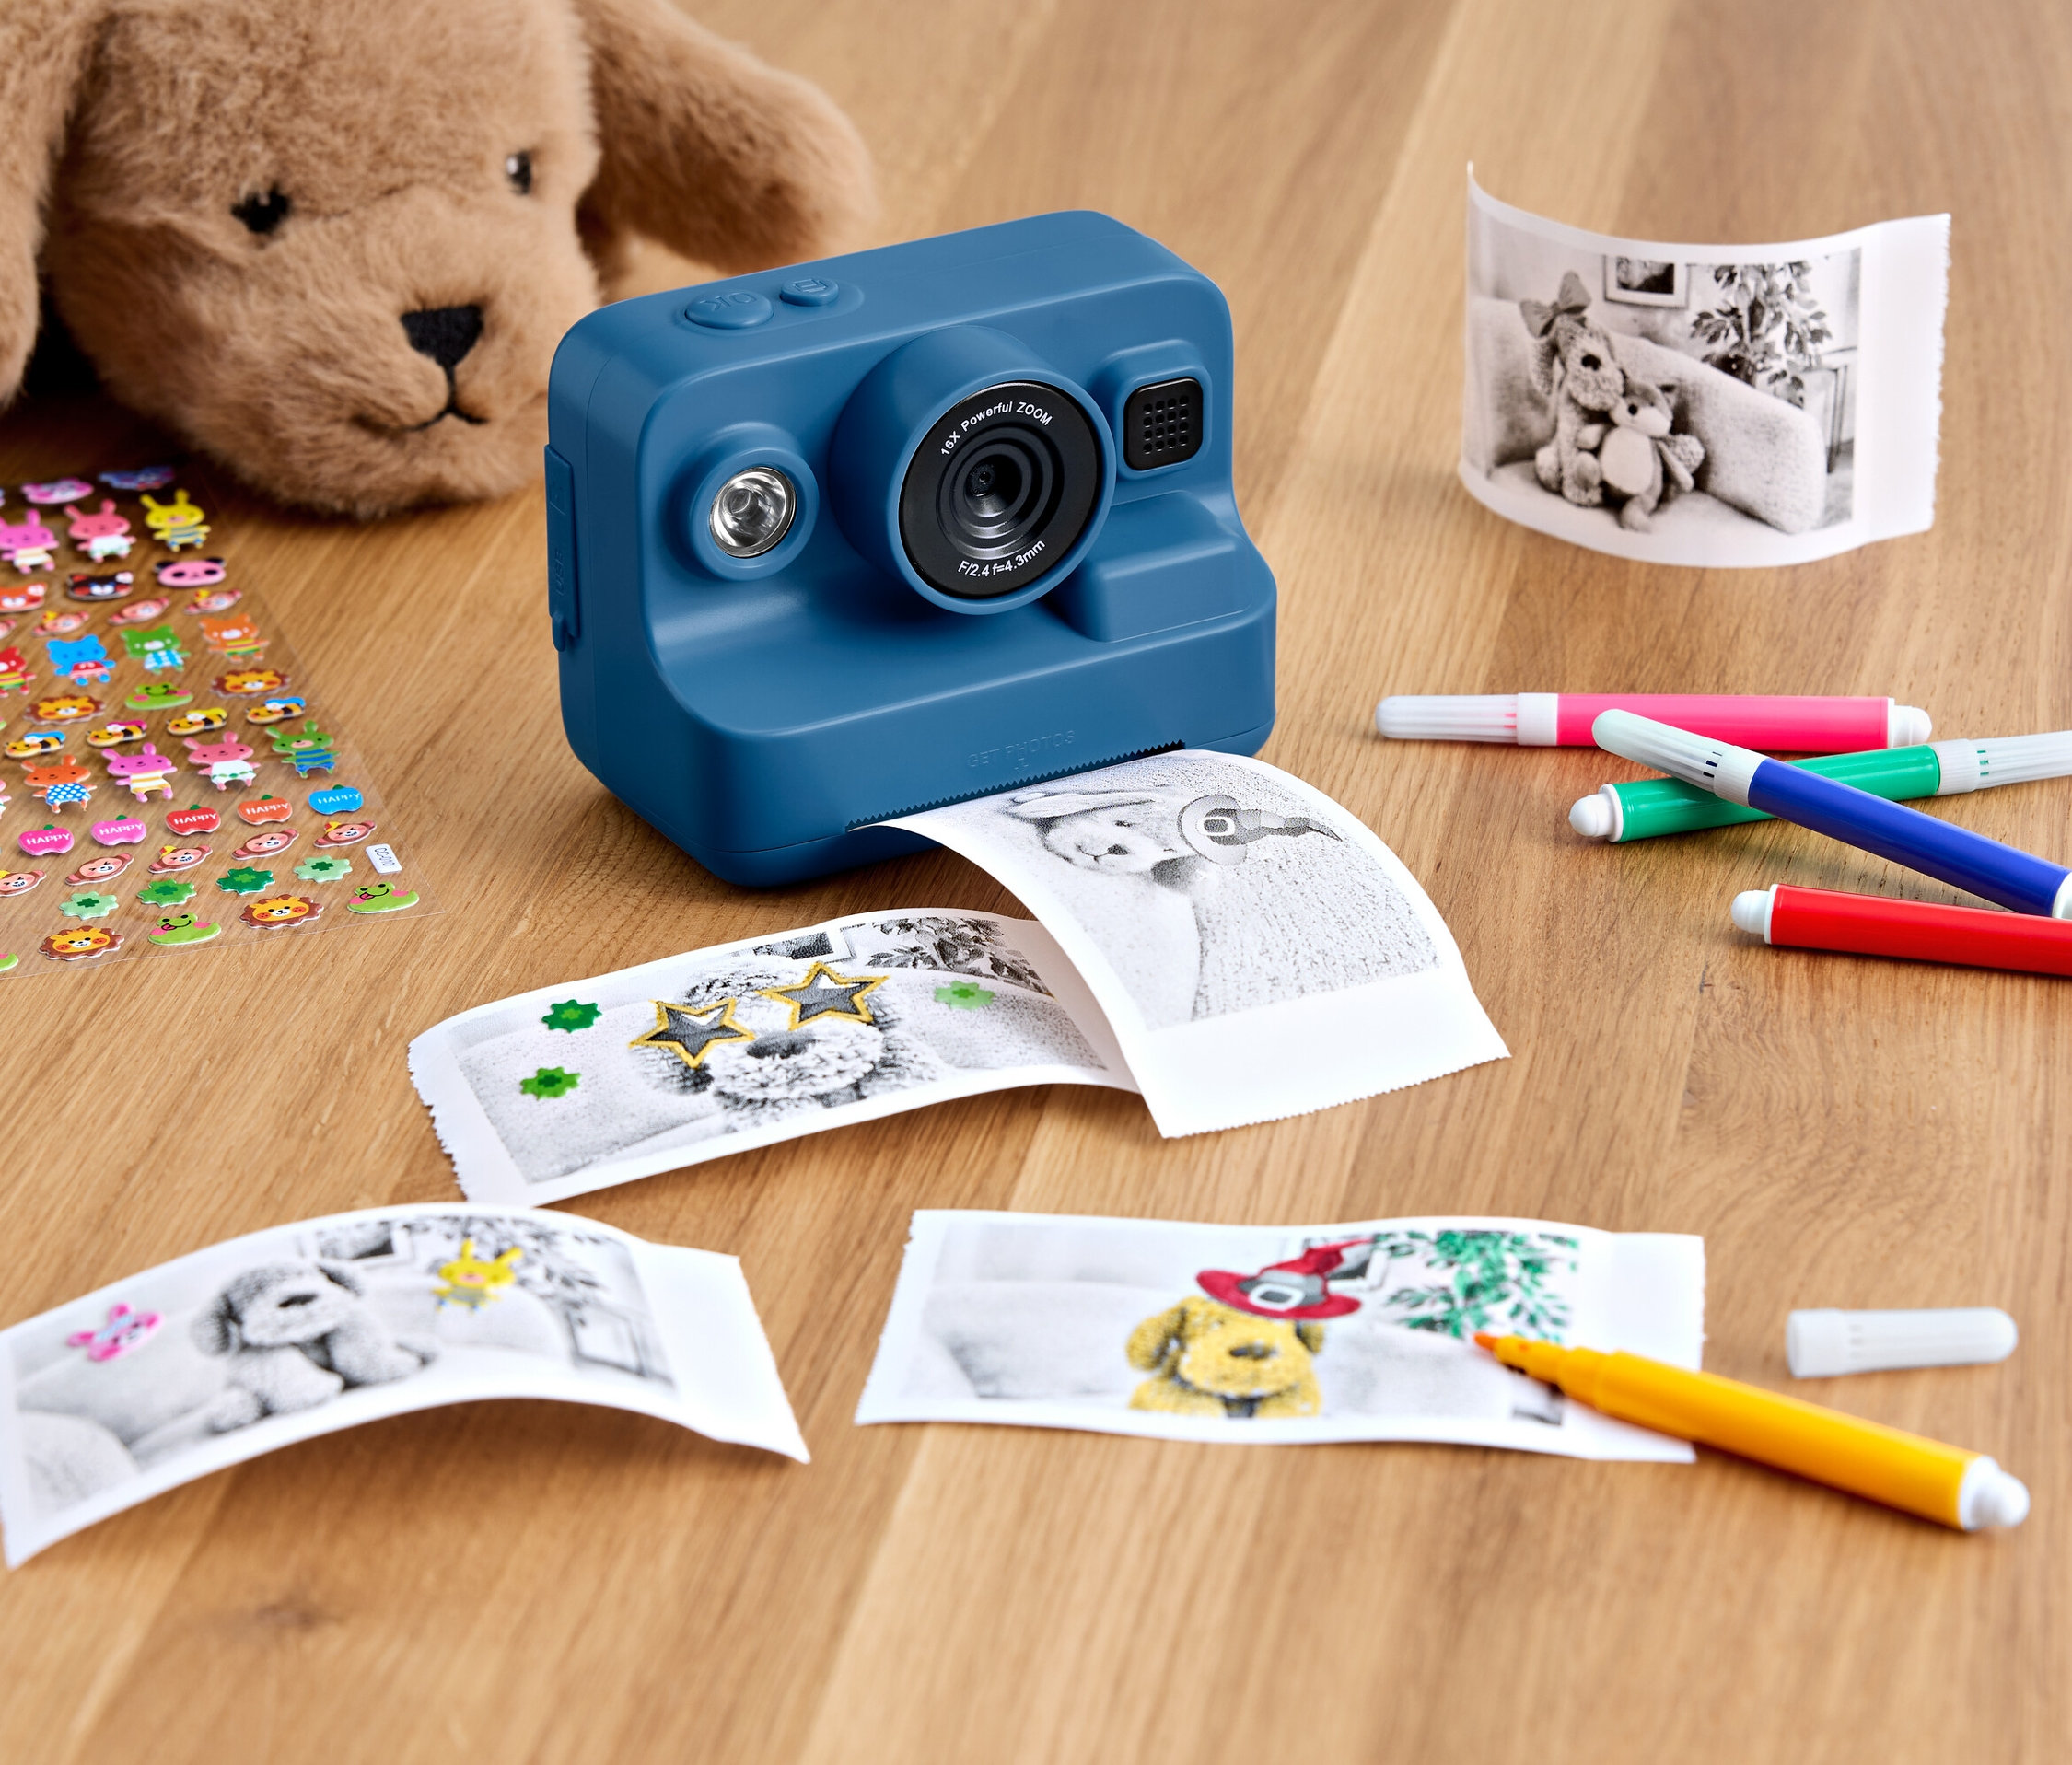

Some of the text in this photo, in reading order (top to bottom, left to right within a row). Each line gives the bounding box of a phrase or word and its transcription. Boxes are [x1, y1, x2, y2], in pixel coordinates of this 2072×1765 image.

[940, 401, 1053, 455] 16X Powerful ZOOM
[958, 540, 1046, 577] F/2.4 f=4.3mm
[966, 729, 1076, 768] GET PHOTOS
[317, 792, 361, 805] HAPPY
[245, 801, 290, 816] HAPPY
[173, 812, 217, 826] HAPPY
[99, 822, 144, 836] HAPPY
[26, 832, 72, 846] HAPPY
